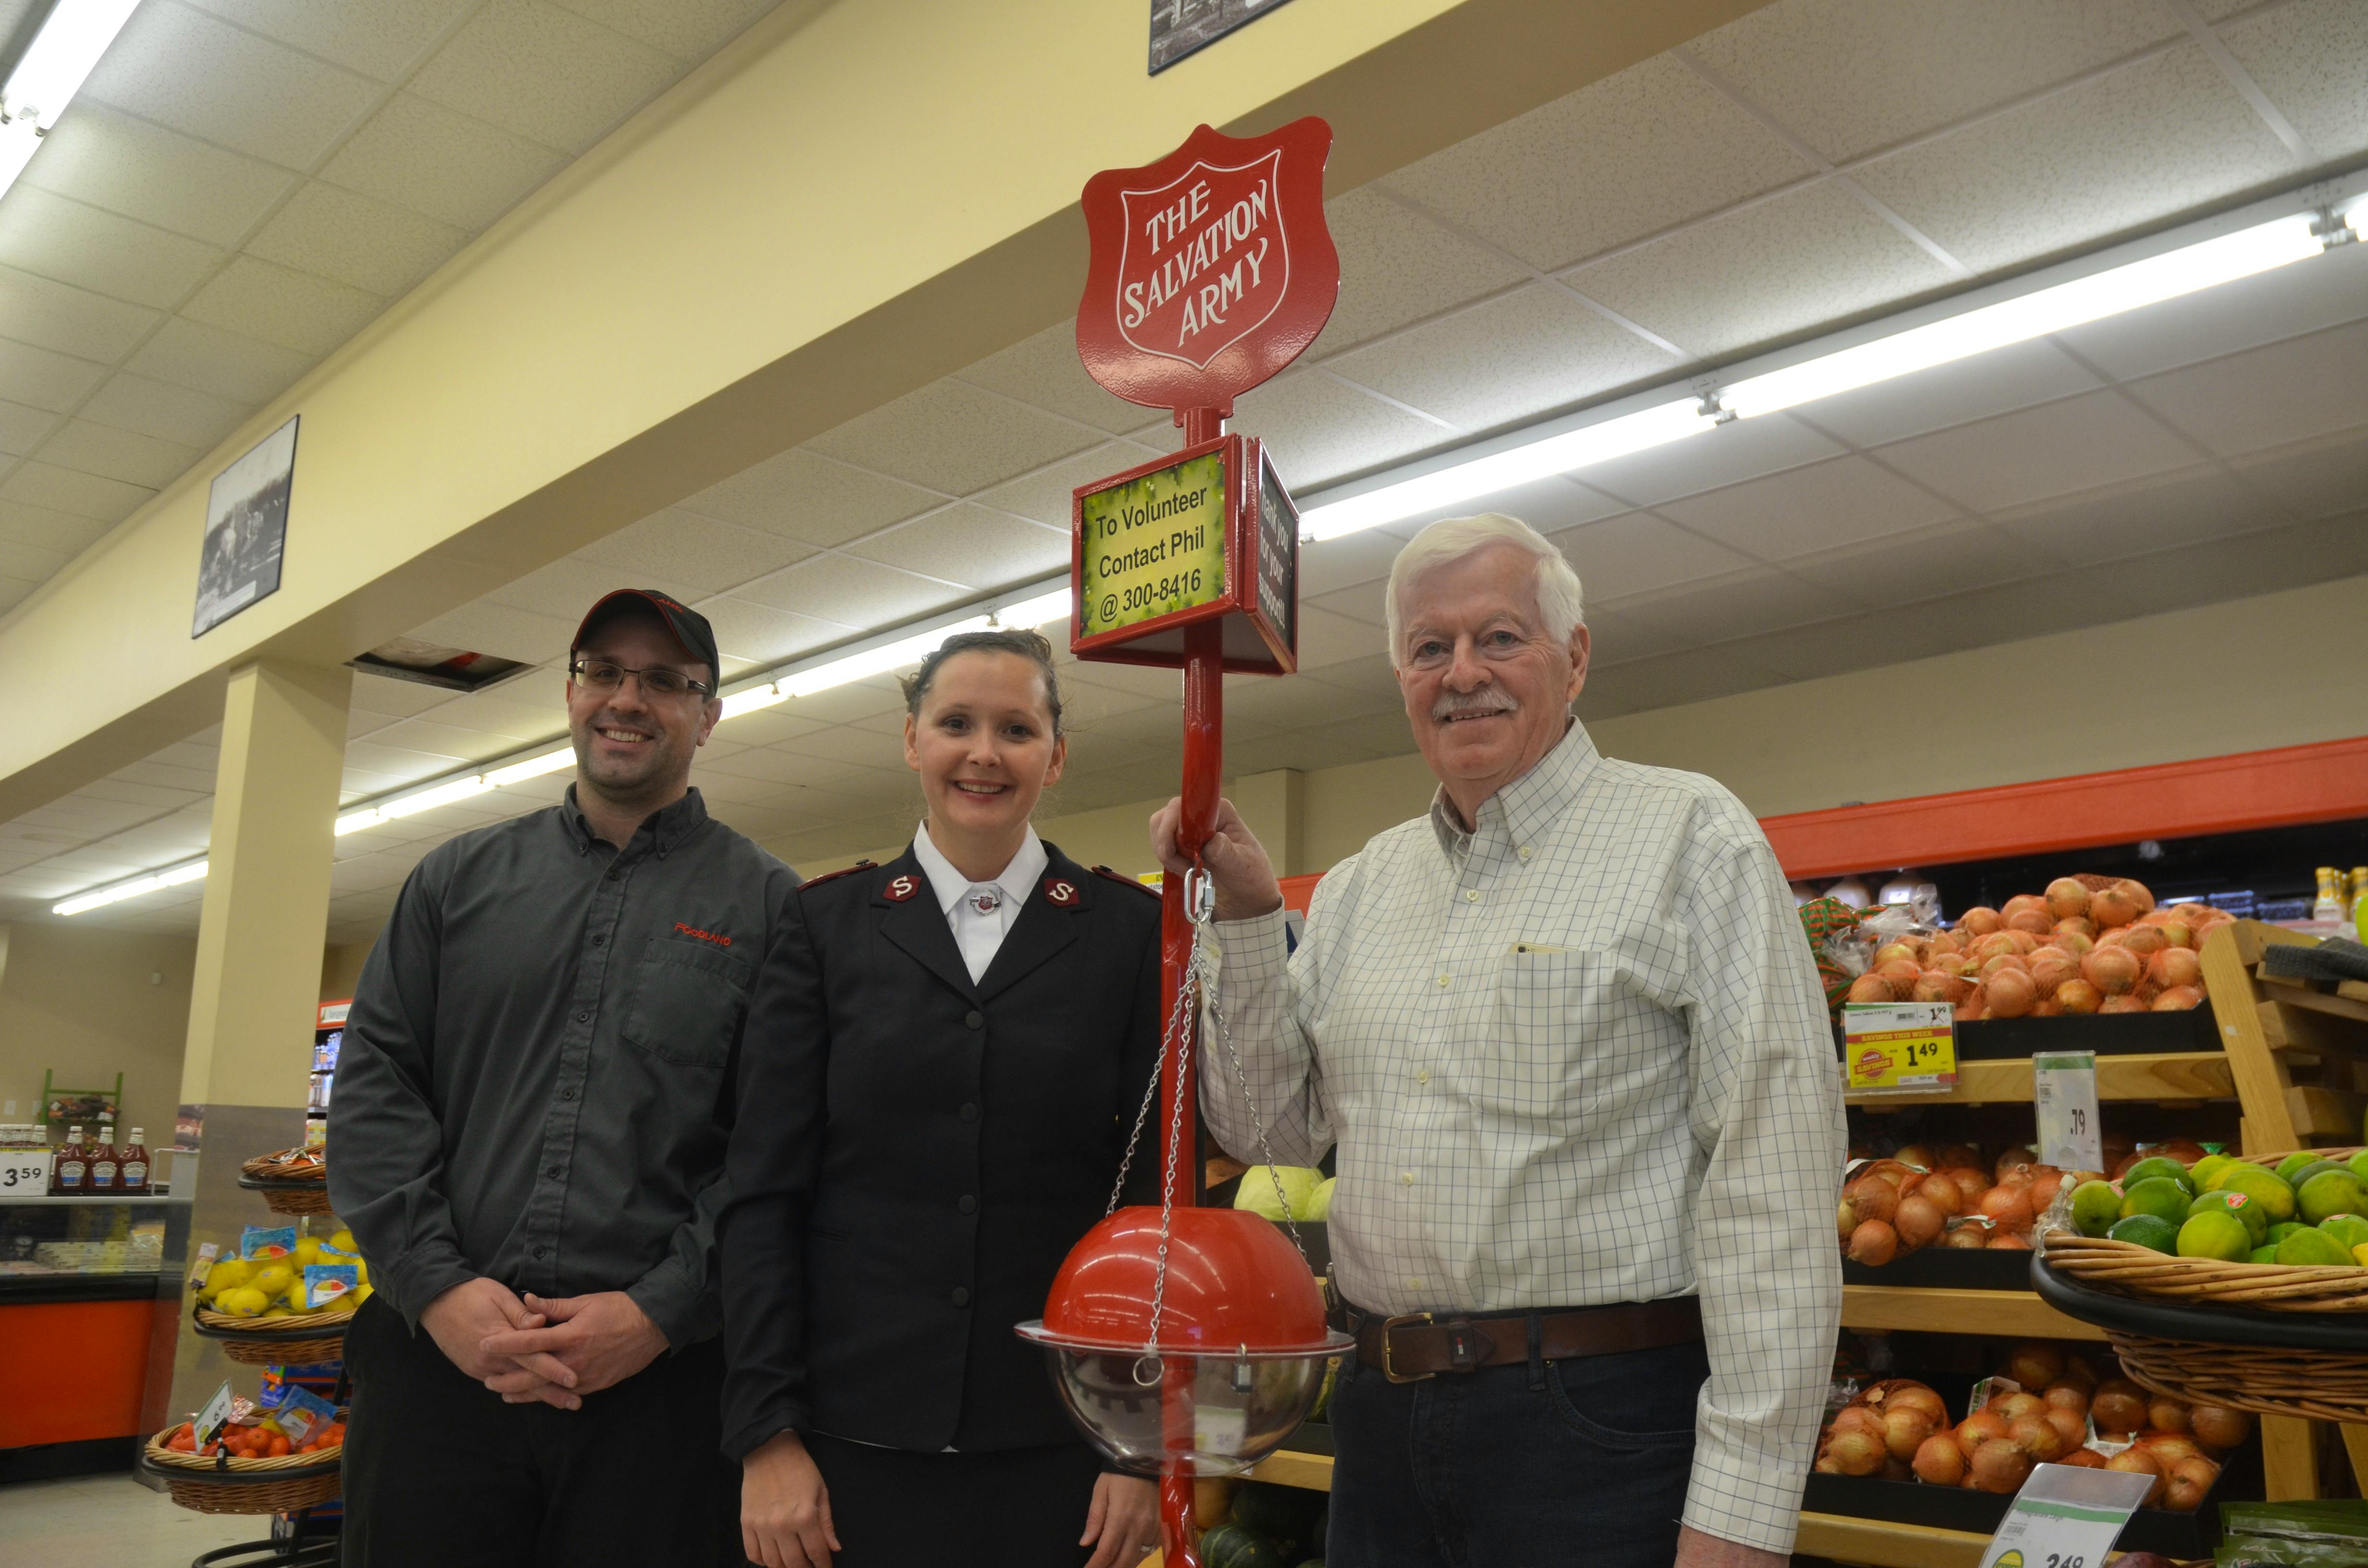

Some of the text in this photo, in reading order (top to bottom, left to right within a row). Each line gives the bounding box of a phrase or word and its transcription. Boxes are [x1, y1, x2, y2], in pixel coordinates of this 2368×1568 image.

[1146, 180, 1211, 255] THE
[1124, 179, 1268, 328] SALVATION
[1177, 237, 1268, 348] ARMY
[1096, 487, 1207, 539] To Volunteer
[1261, 482, 1289, 553] hank you
[1099, 525, 1205, 578] Contact Phil
[1260, 526, 1283, 585] for your
[1100, 568, 1201, 623] @ 300-8416
[892, 876, 912, 897] S
[1049, 882, 1073, 901] S
[675, 922, 731, 946] FOODLAND
[1862, 1033, 1892, 1041] SAVINGS
[1857, 1059, 1890, 1072] SAVINGS
